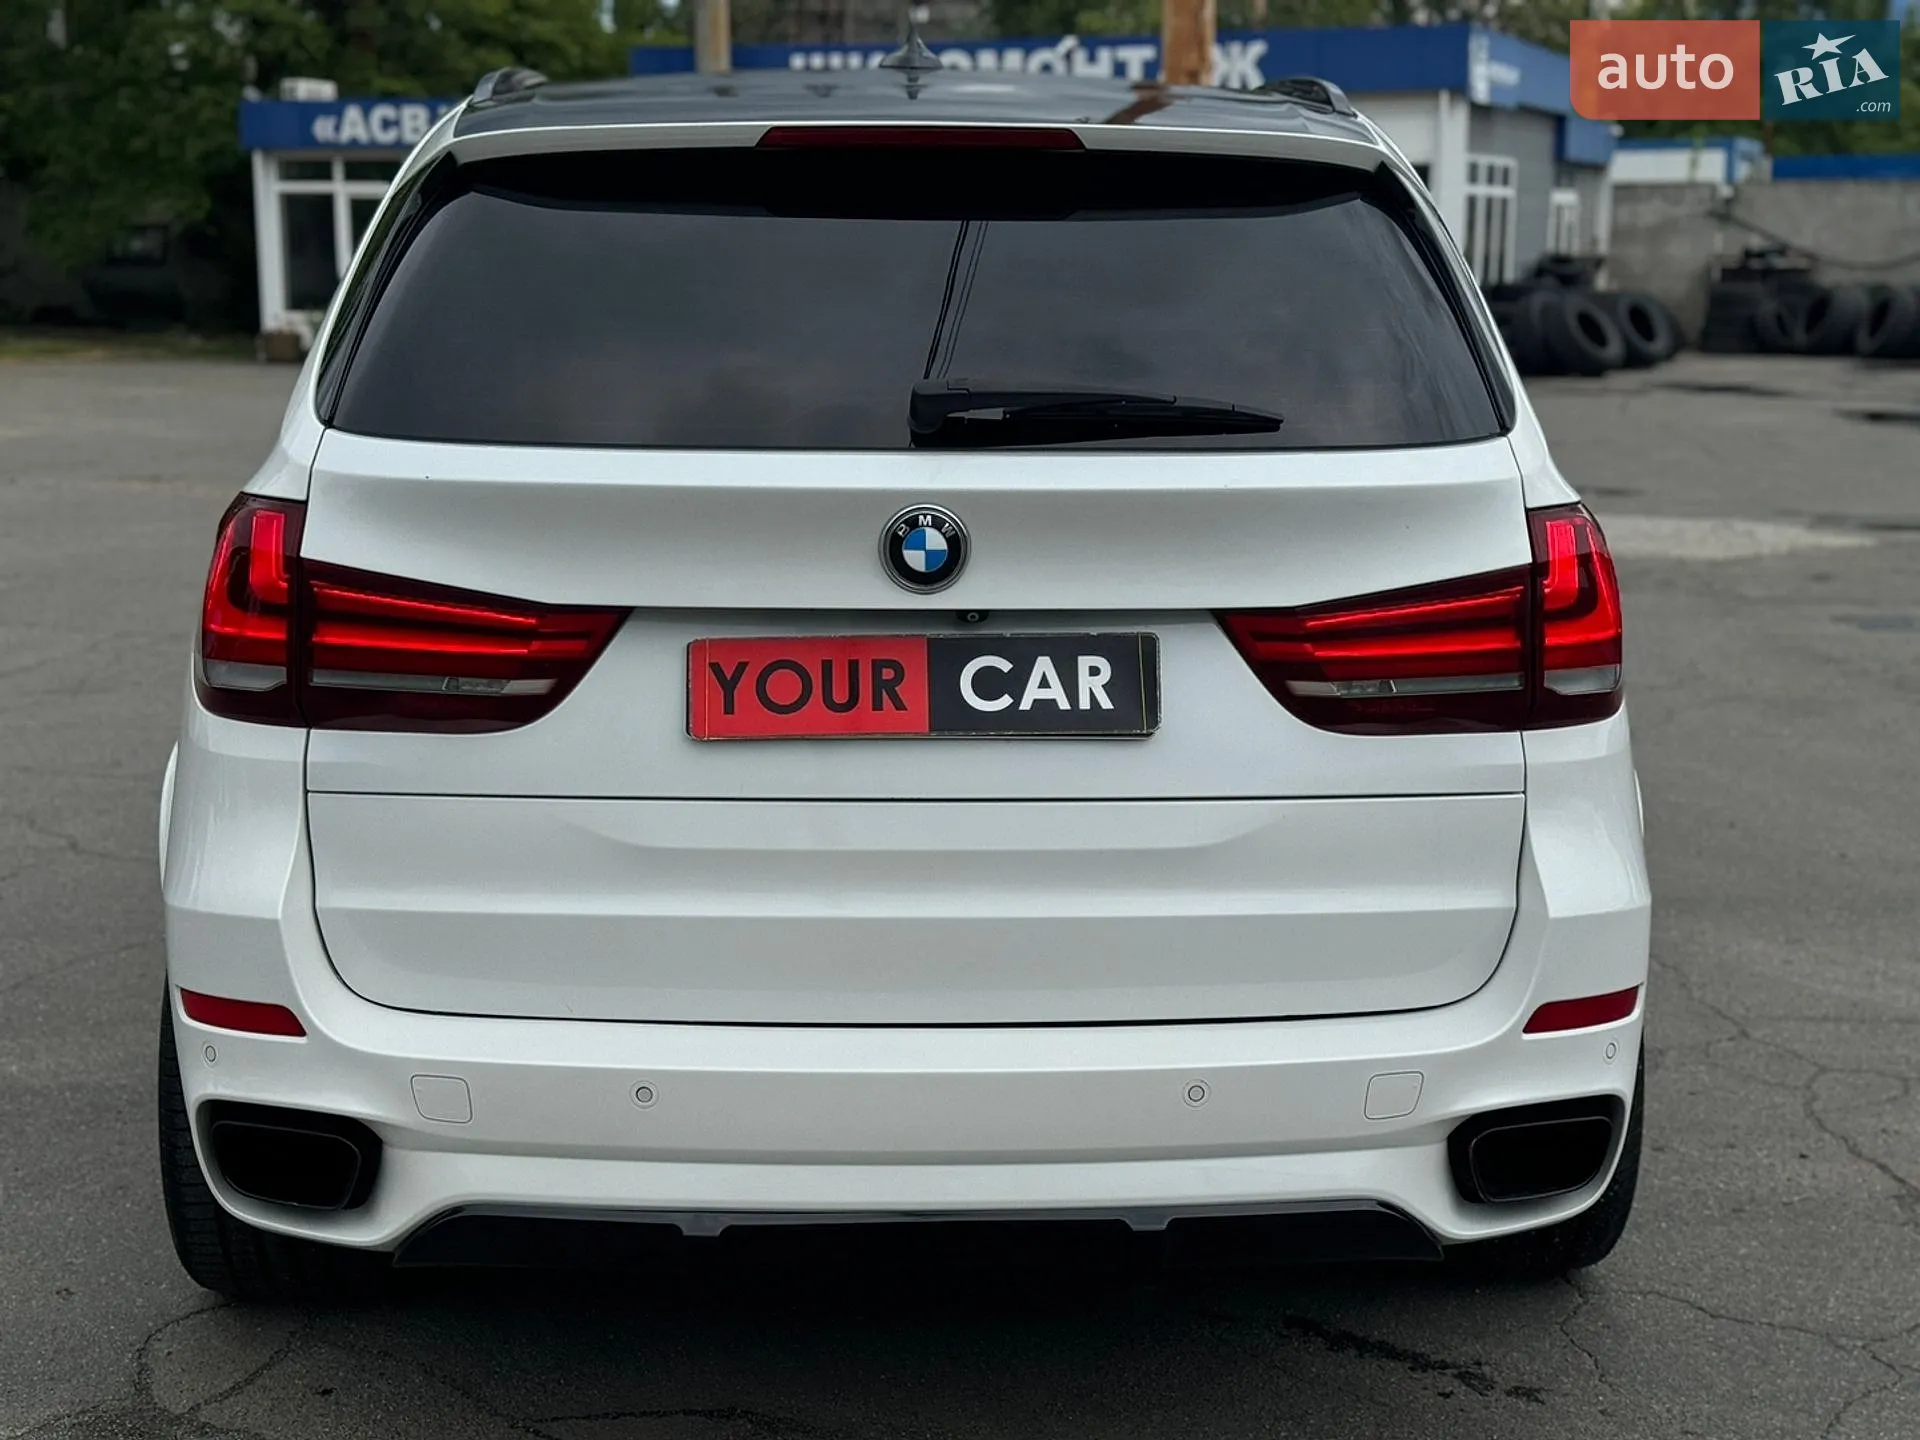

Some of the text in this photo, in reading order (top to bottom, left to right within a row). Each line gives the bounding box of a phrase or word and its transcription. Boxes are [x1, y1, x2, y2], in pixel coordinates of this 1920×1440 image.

[896, 514, 956, 538] BMW
[709, 654, 1114, 715] YOUR CAR
